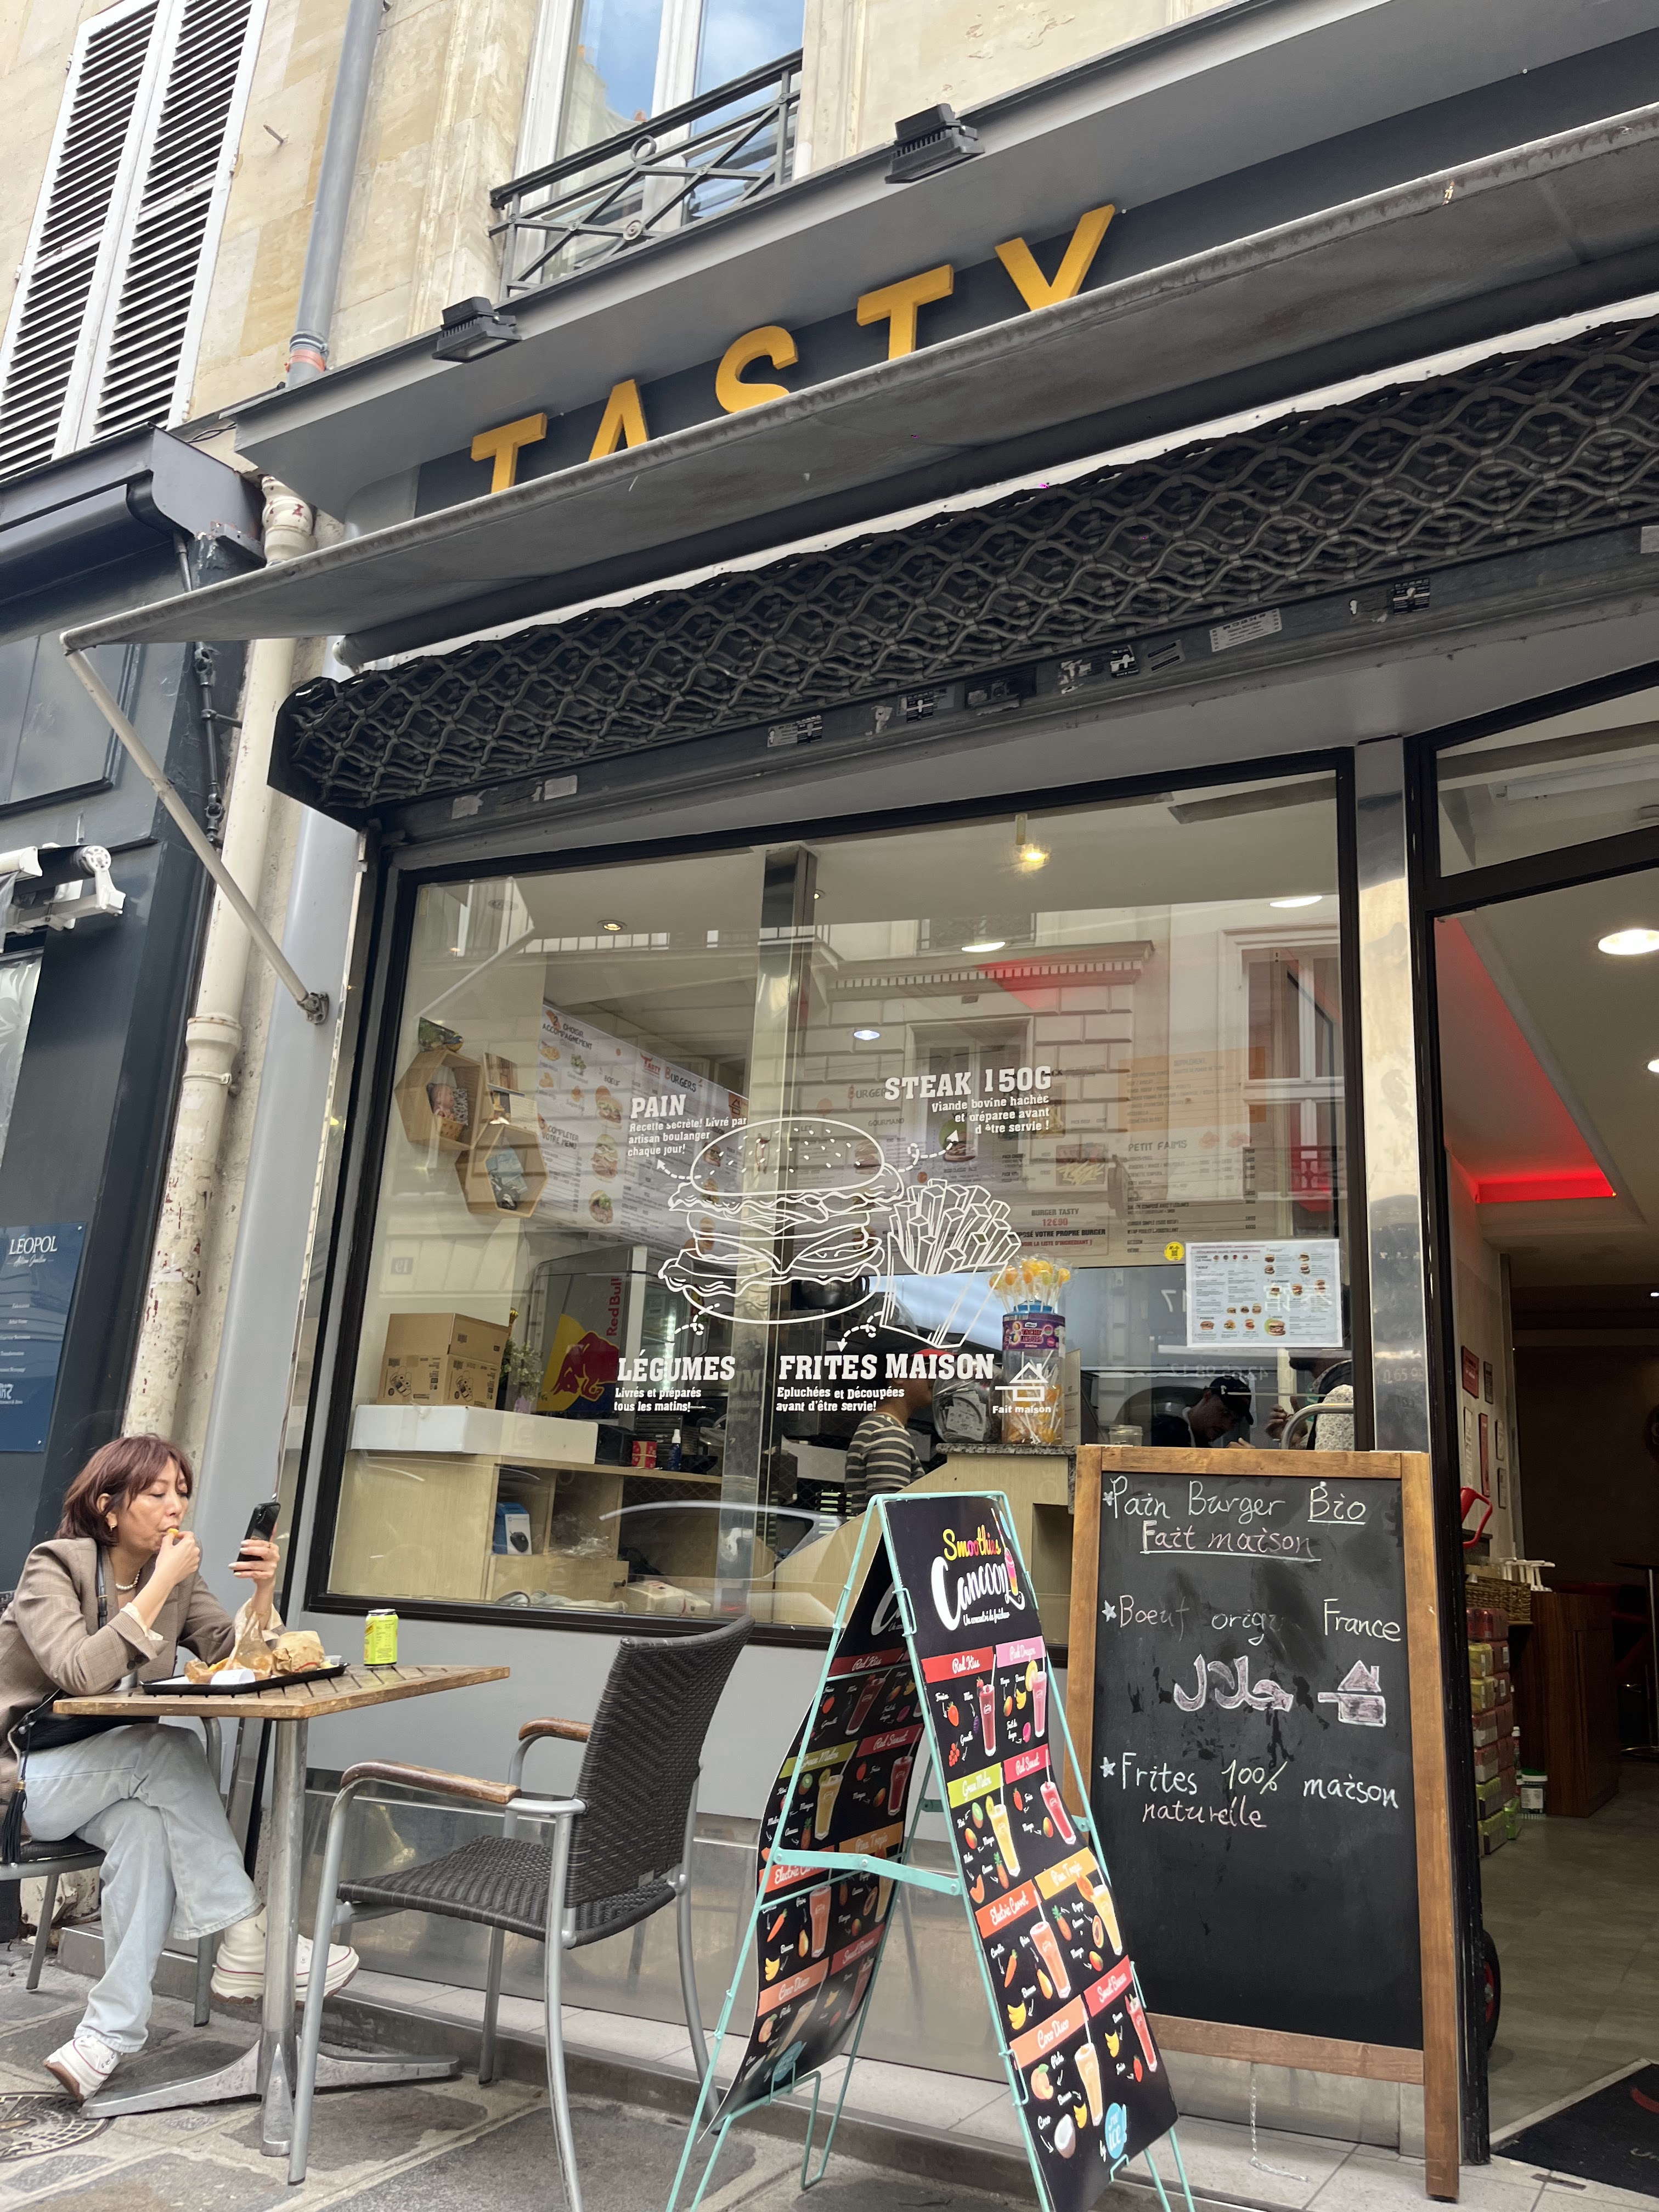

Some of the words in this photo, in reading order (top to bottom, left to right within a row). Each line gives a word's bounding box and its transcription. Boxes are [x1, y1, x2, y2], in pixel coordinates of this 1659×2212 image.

[470, 204, 1115, 495] TASTY
[848, 1085, 892, 1099] BURGER
[885, 1071, 972, 1101] STEAK
[985, 1066, 1051, 1093] 150G
[631, 1094, 686, 1119] PAIN
[932, 1101, 968, 1113] Viande
[972, 1098, 1007, 1109] bovine
[1010, 1093, 1049, 1105] hachée
[706, 1117, 729, 1127] Livré
[731, 1117, 747, 1128] par
[955, 1113, 965, 1122] et
[1019, 1107, 1049, 1119] avant
[1008, 1122, 1041, 1132] servie
[629, 1134, 660, 1144] artisan
[663, 1131, 710, 1142] boulanger
[1128, 1142, 1153, 1152] PETIT
[628, 1147, 662, 1157] chaque
[663, 1144, 686, 1155] jour!
[8, 1233, 58, 1255] LÉOPOL
[609, 1277, 622, 1306] Bull
[606, 1307, 620, 1336] Red
[617, 1349, 736, 1381] LÉGUMES
[779, 1354, 878, 1380] FRITES
[885, 1353, 995, 1380] MAISON
[615, 1386, 645, 1398] Livrés
[647, 1387, 656, 1398] et
[659, 1386, 702, 1400] préparés
[777, 1386, 831, 1400] Epluchées
[834, 1390, 844, 1400] et
[847, 1387, 905, 1400] Découpées
[614, 1402, 635, 1411] tous
[637, 1401, 652, 1412] les
[654, 1401, 691, 1412] matins!
[776, 1402, 805, 1412] avant
[808, 1400, 838, 1412] d'être
[840, 1400, 877, 1412] servie!
[992, 1405, 1012, 1414] Fait
[1015, 1405, 1052, 1414] maison
[1110, 1475, 1171, 1519] Pain
[1188, 1481, 1285, 1525] Burger
[1309, 1481, 1366, 1521] Bio
[943, 1524, 1002, 1561] Smoothies
[1142, 1519, 1197, 1554] Fait
[1207, 1527, 1315, 1559] maison
[931, 1556, 1025, 1632] Cancoon
[1120, 1594, 1190, 1642] Boeuf
[1323, 1598, 1402, 1642] France
[851, 1658, 865, 1671] Red
[952, 1655, 967, 1674] Red
[966, 1655, 981, 1671] Kiss
[1173, 1654, 1295, 1712] حلال
[873, 1735, 888, 1751] Red
[1121, 1752, 1198, 1796] Frites
[1221, 1759, 1289, 1795] 100%
[1303, 1773, 1400, 1809] maison
[774, 1865, 800, 1885] Electric
[990, 1900, 1011, 1926] Electric
[778, 1984, 794, 2001] Coco
[1037, 2029, 1054, 2049] Coco
[1052, 2019, 1069, 2038] Disco
